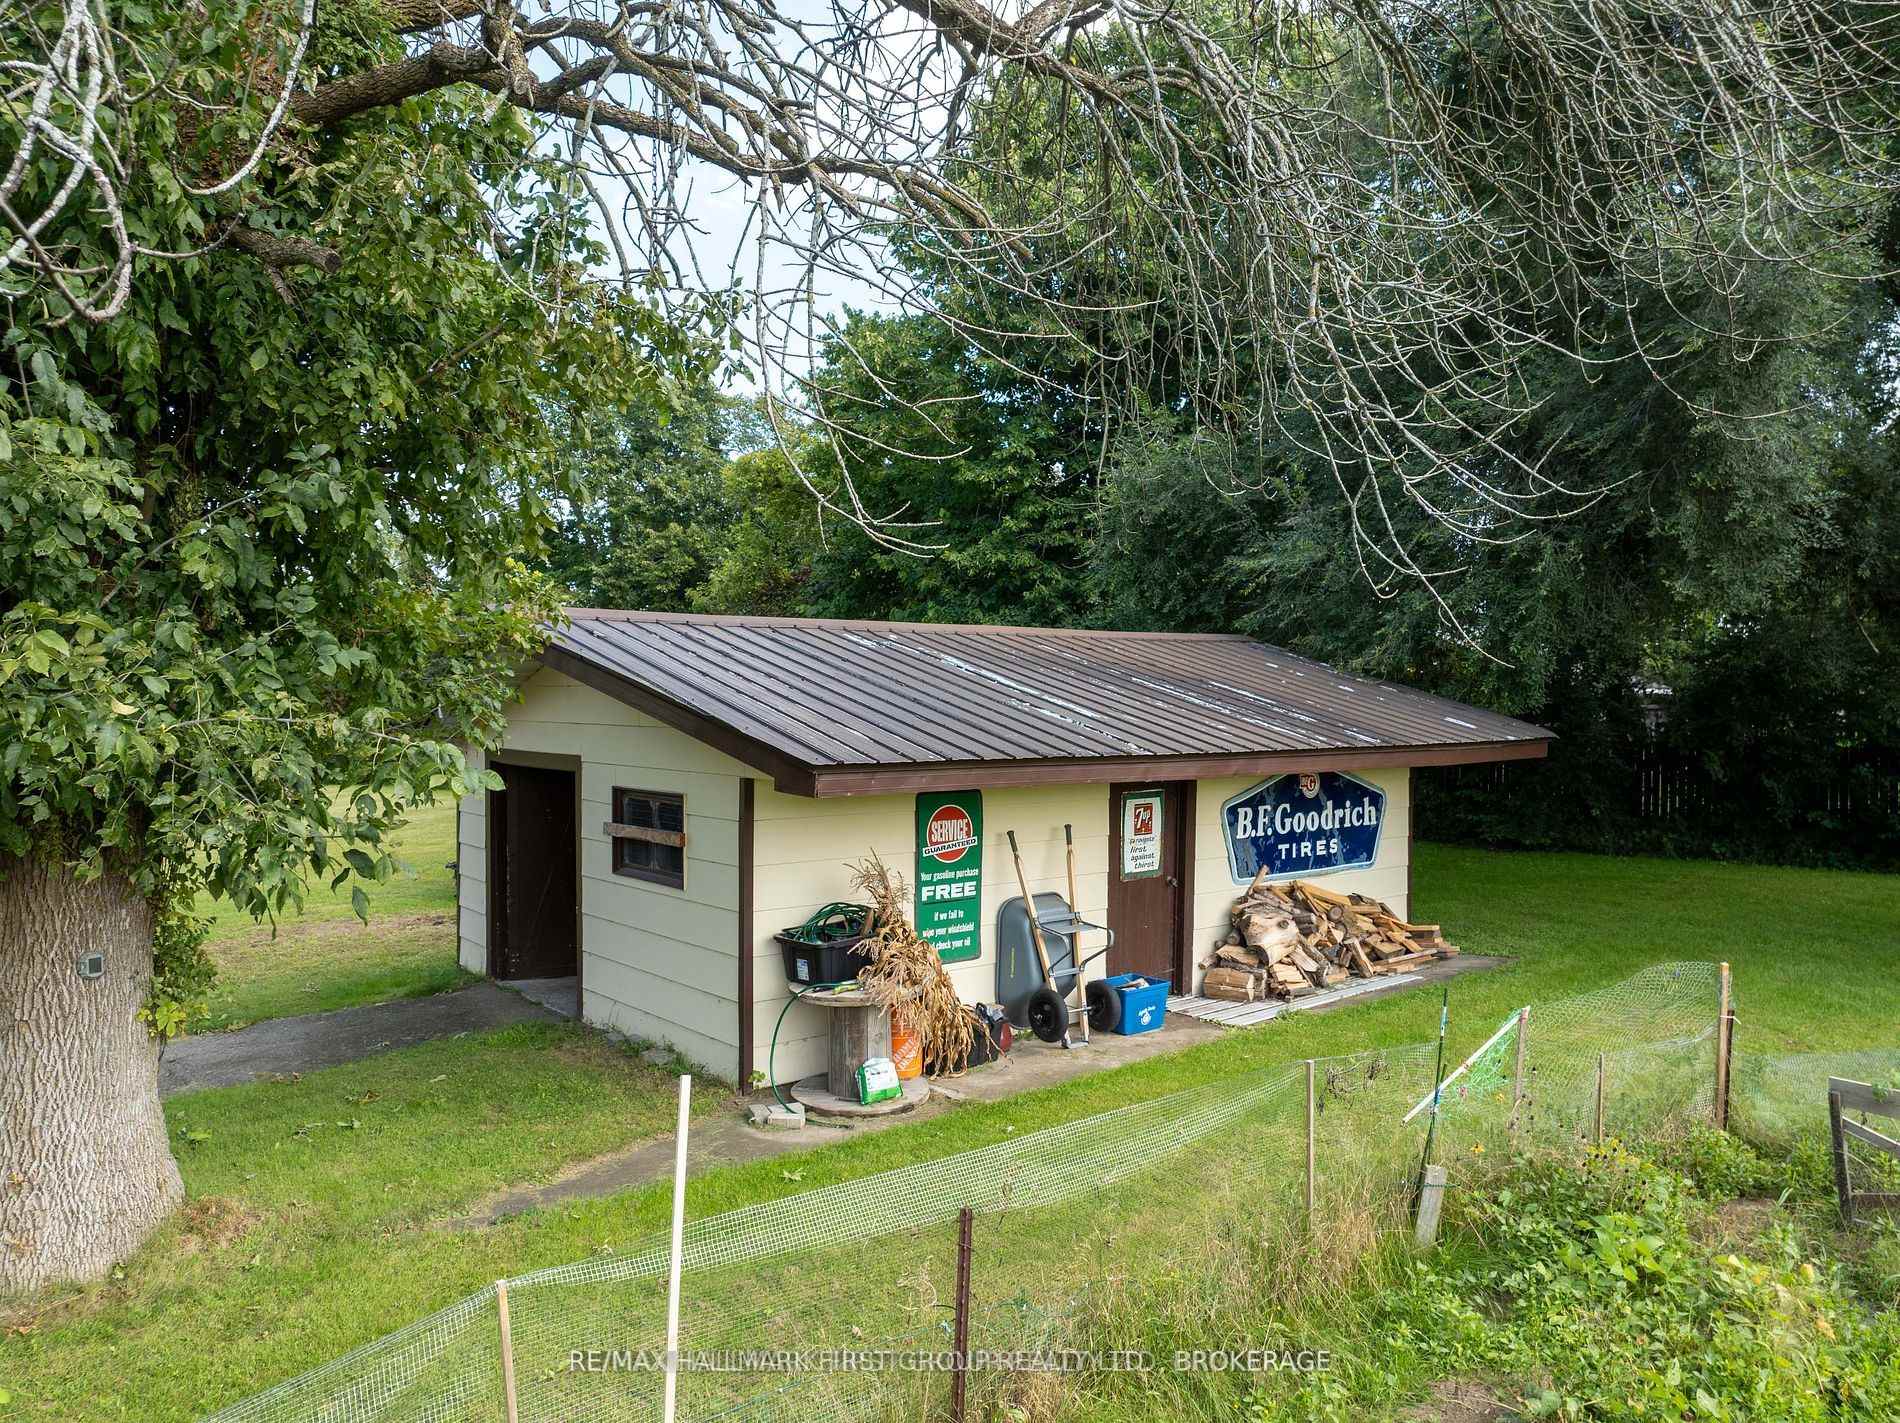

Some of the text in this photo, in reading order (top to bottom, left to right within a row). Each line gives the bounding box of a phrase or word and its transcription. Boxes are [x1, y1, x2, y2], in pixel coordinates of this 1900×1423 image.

[931, 818, 969, 843] SERVICE
[924, 838, 977, 855] GUARANTEED
[1130, 846, 1147, 854] first
[1278, 838, 1339, 860] TIRES
[1130, 853, 1155, 862] against
[1134, 861, 1154, 869] thirst
[920, 868, 979, 882] Your gasoline purchase
[921, 881, 977, 902] FREE
[939, 912, 948, 921] we
[948, 909, 958, 919] fail
[958, 909, 964, 918] to
[922, 922, 975, 938] wipe your windshield
[936, 939, 952, 950] check
[951, 939, 964, 950] your
